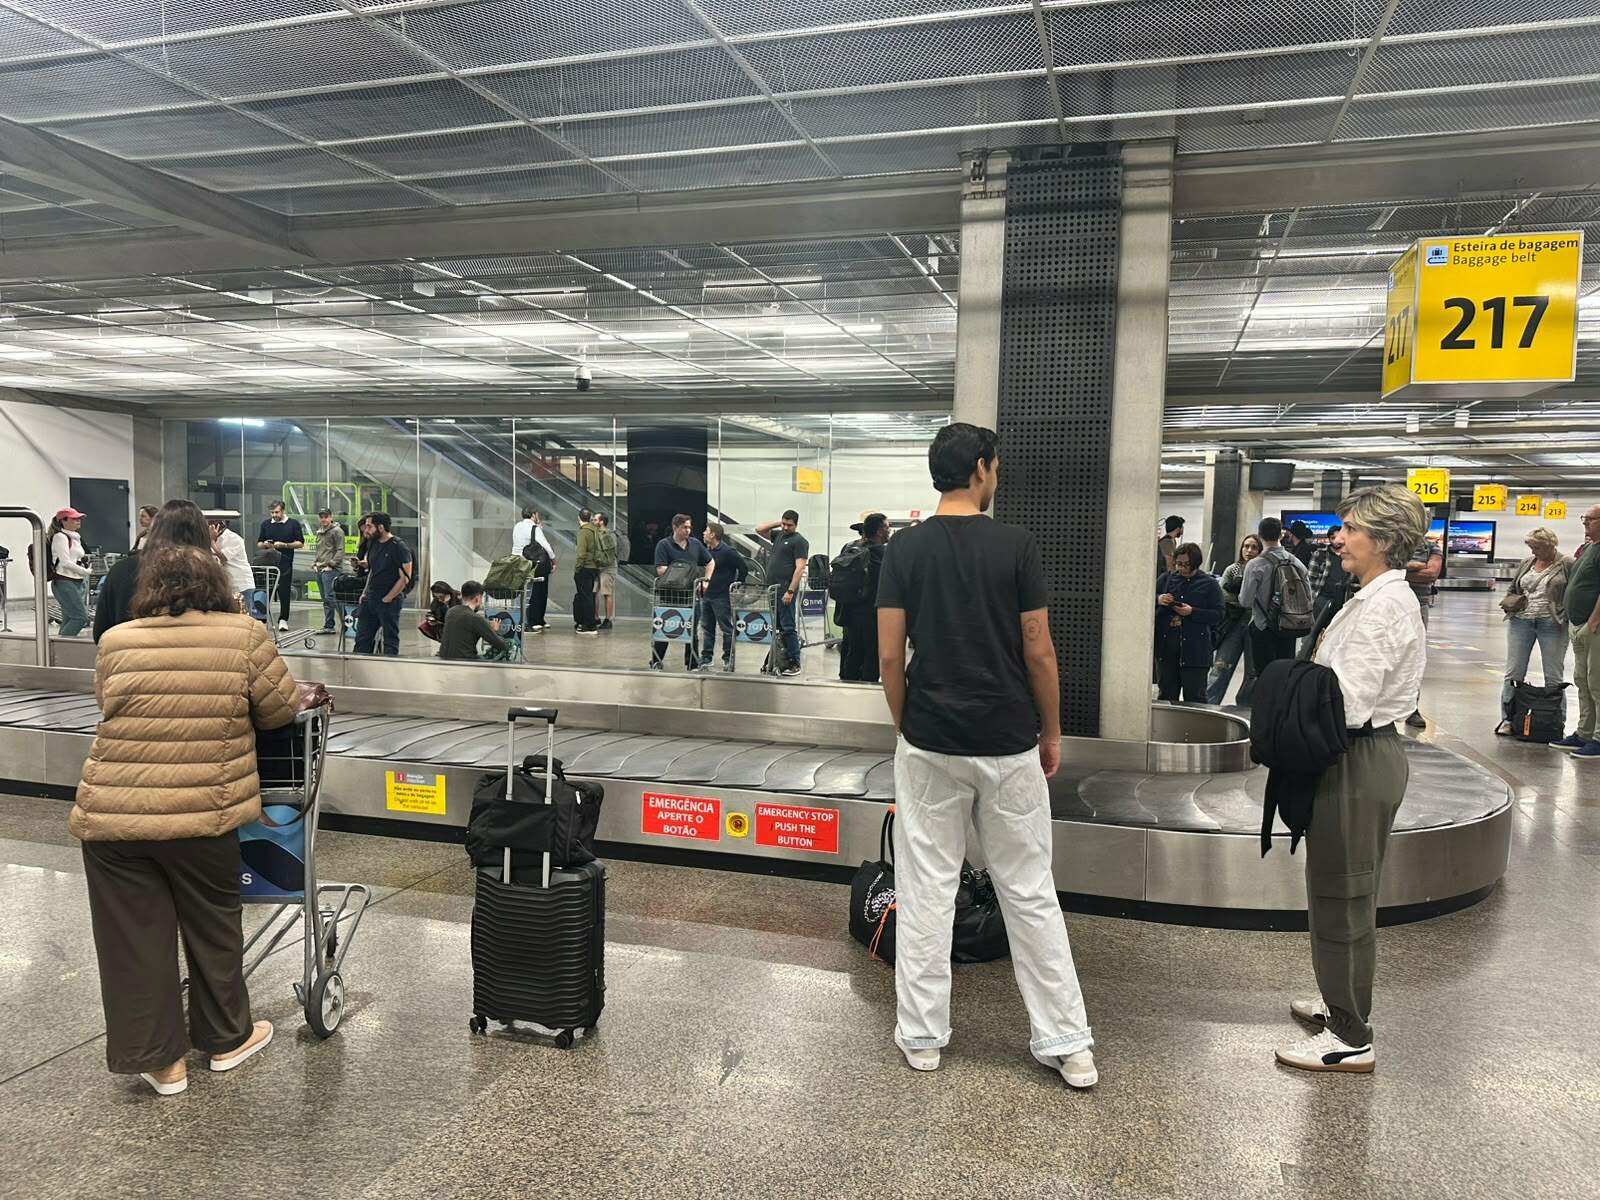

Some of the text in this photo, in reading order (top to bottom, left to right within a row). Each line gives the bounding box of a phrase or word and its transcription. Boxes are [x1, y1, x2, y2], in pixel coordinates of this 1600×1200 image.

[1453, 239, 1578, 252] Esteira de bagagem
[1453, 252, 1536, 267] Baggage belt
[1440, 295, 1550, 350] 217
[1387, 305, 1410, 365] 217
[1414, 482, 1439, 495] 216
[1478, 495, 1496, 505] 215
[1520, 503, 1536, 511] 214
[649, 797, 714, 813] EMERGÊNCIA
[657, 811, 704, 823] APERTE O
[758, 806, 834, 822] EMERGENCY STOP
[663, 825, 697, 836] BOTÃO
[774, 821, 816, 834] PUSH THE
[777, 835, 813, 847] BUTTON
